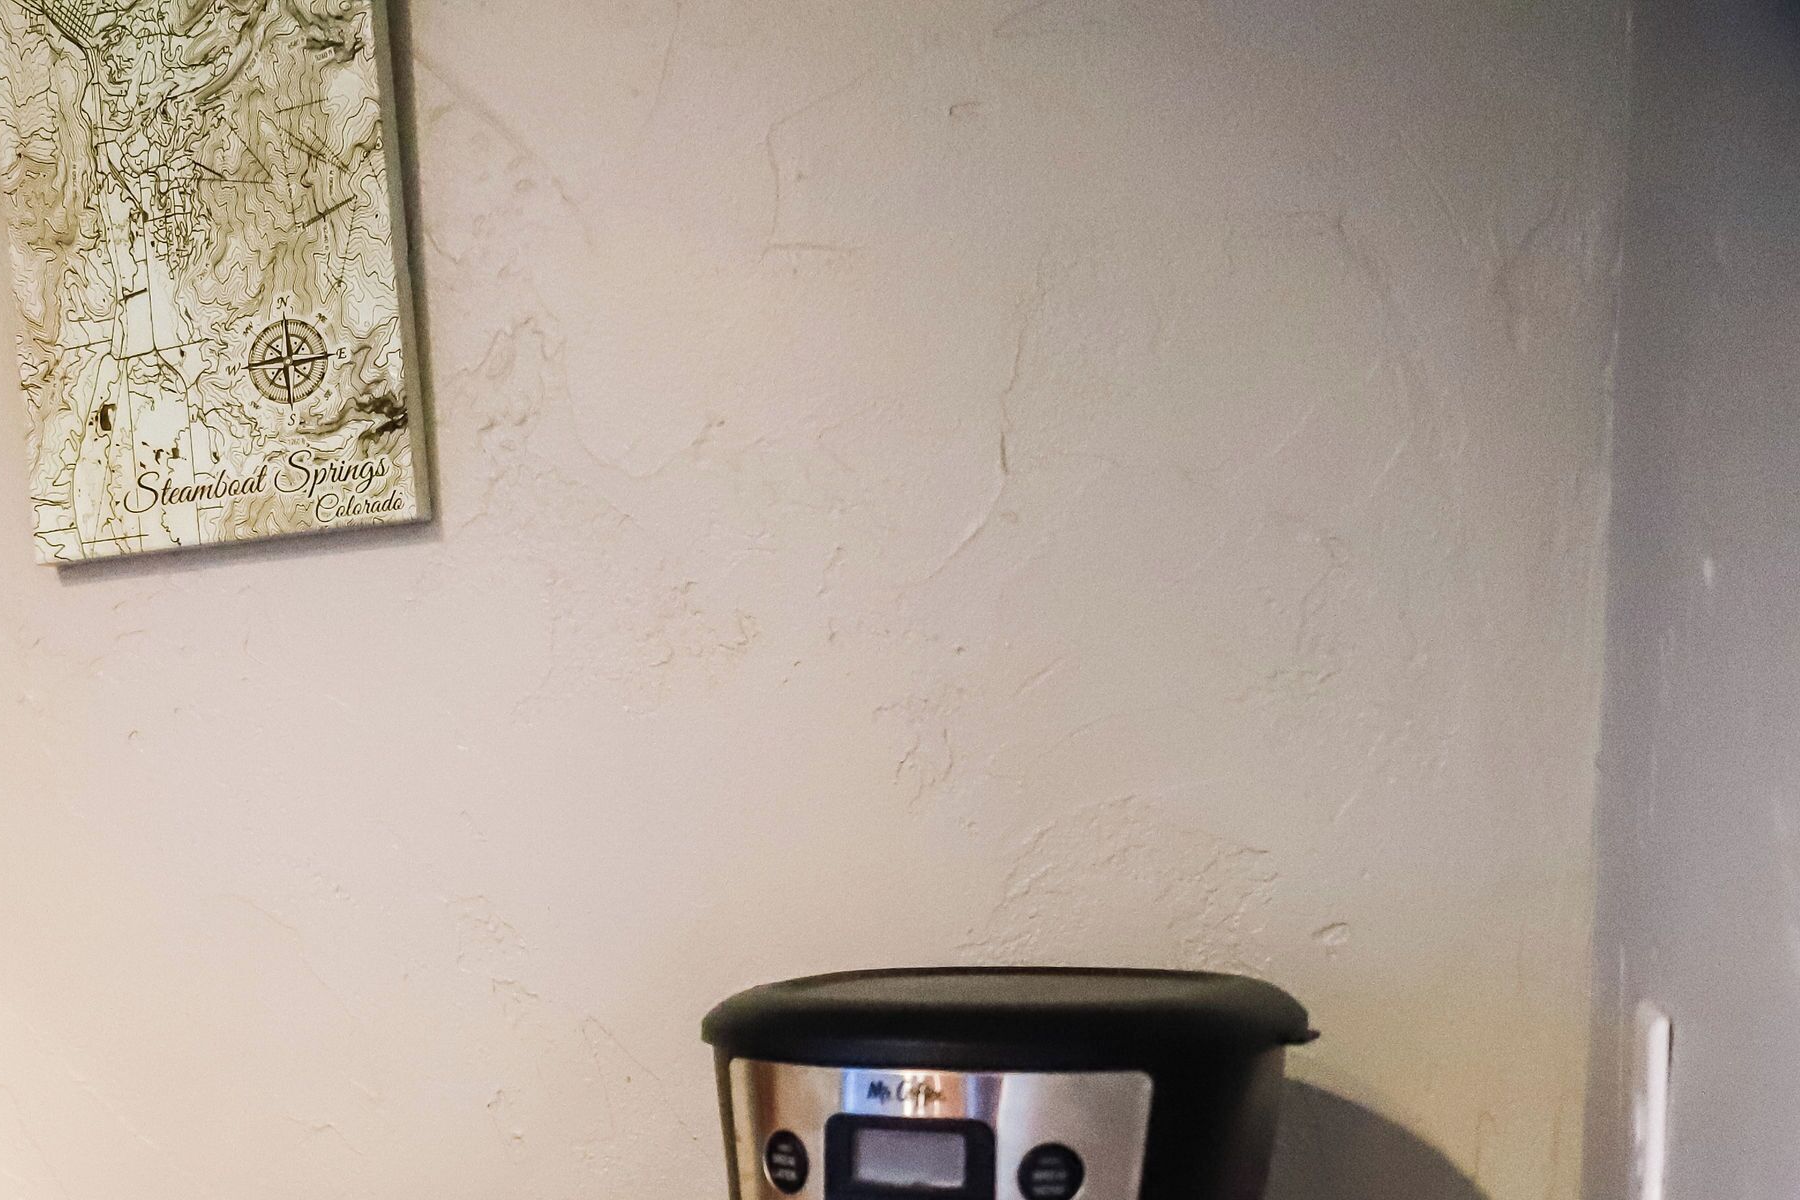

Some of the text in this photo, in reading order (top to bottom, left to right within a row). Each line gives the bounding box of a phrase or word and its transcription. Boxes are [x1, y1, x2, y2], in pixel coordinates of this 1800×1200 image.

[277, 296, 290, 310] N
[336, 347, 347, 359] E
[225, 363, 241, 376] W
[288, 413, 296, 426] S
[124, 450, 391, 513] Steamboat Springs
[315, 490, 406, 522] Colorado
